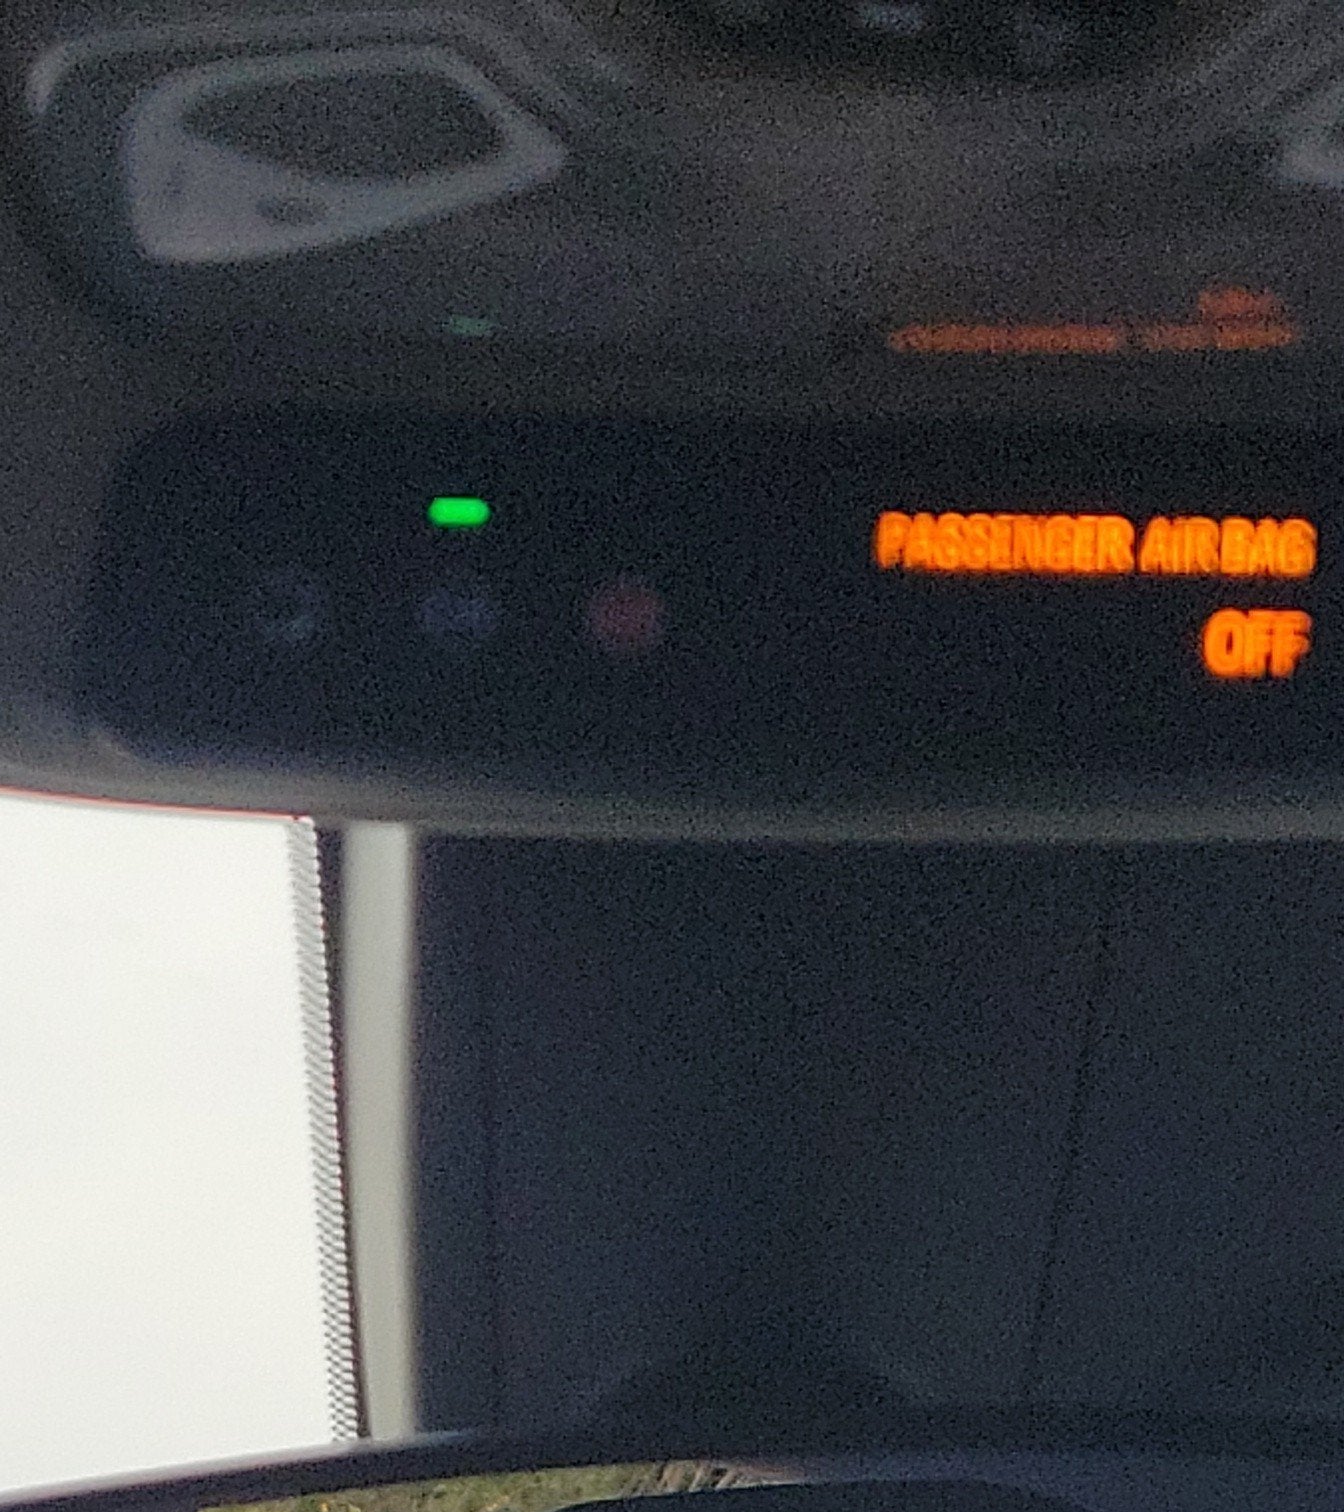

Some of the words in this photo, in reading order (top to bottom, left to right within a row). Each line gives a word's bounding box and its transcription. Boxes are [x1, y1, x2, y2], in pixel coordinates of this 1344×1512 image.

[875, 511, 1135, 573] PASSENGER
[1139, 515, 1317, 577] AIRBAG
[1201, 607, 1311, 677] OFF
